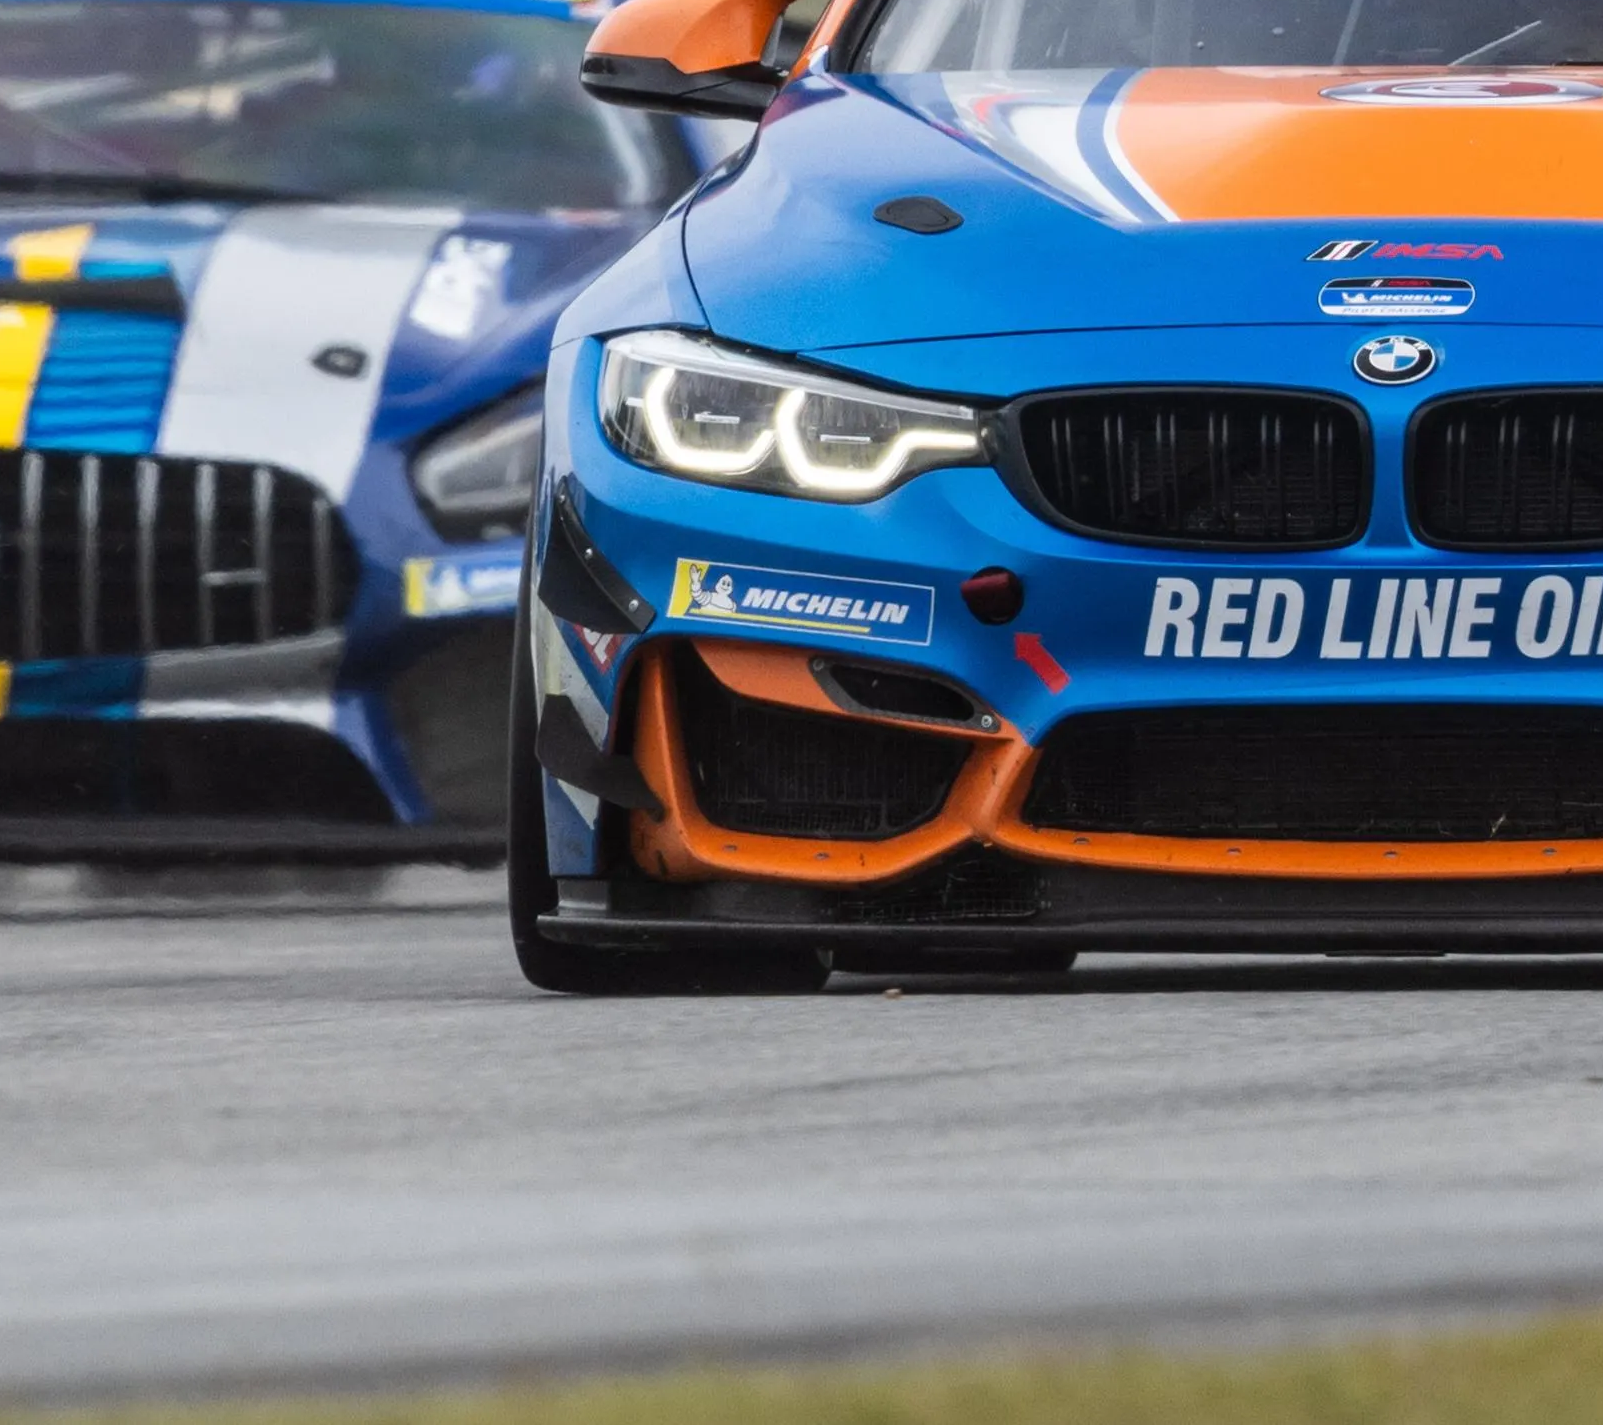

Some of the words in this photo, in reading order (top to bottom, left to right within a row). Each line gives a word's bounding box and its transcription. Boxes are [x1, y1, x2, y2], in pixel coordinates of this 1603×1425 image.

[1371, 243, 1505, 260] IMSA
[740, 586, 911, 626] MICHELIN
[1143, 576, 1305, 659] RED
[1318, 577, 1502, 660] LINE
